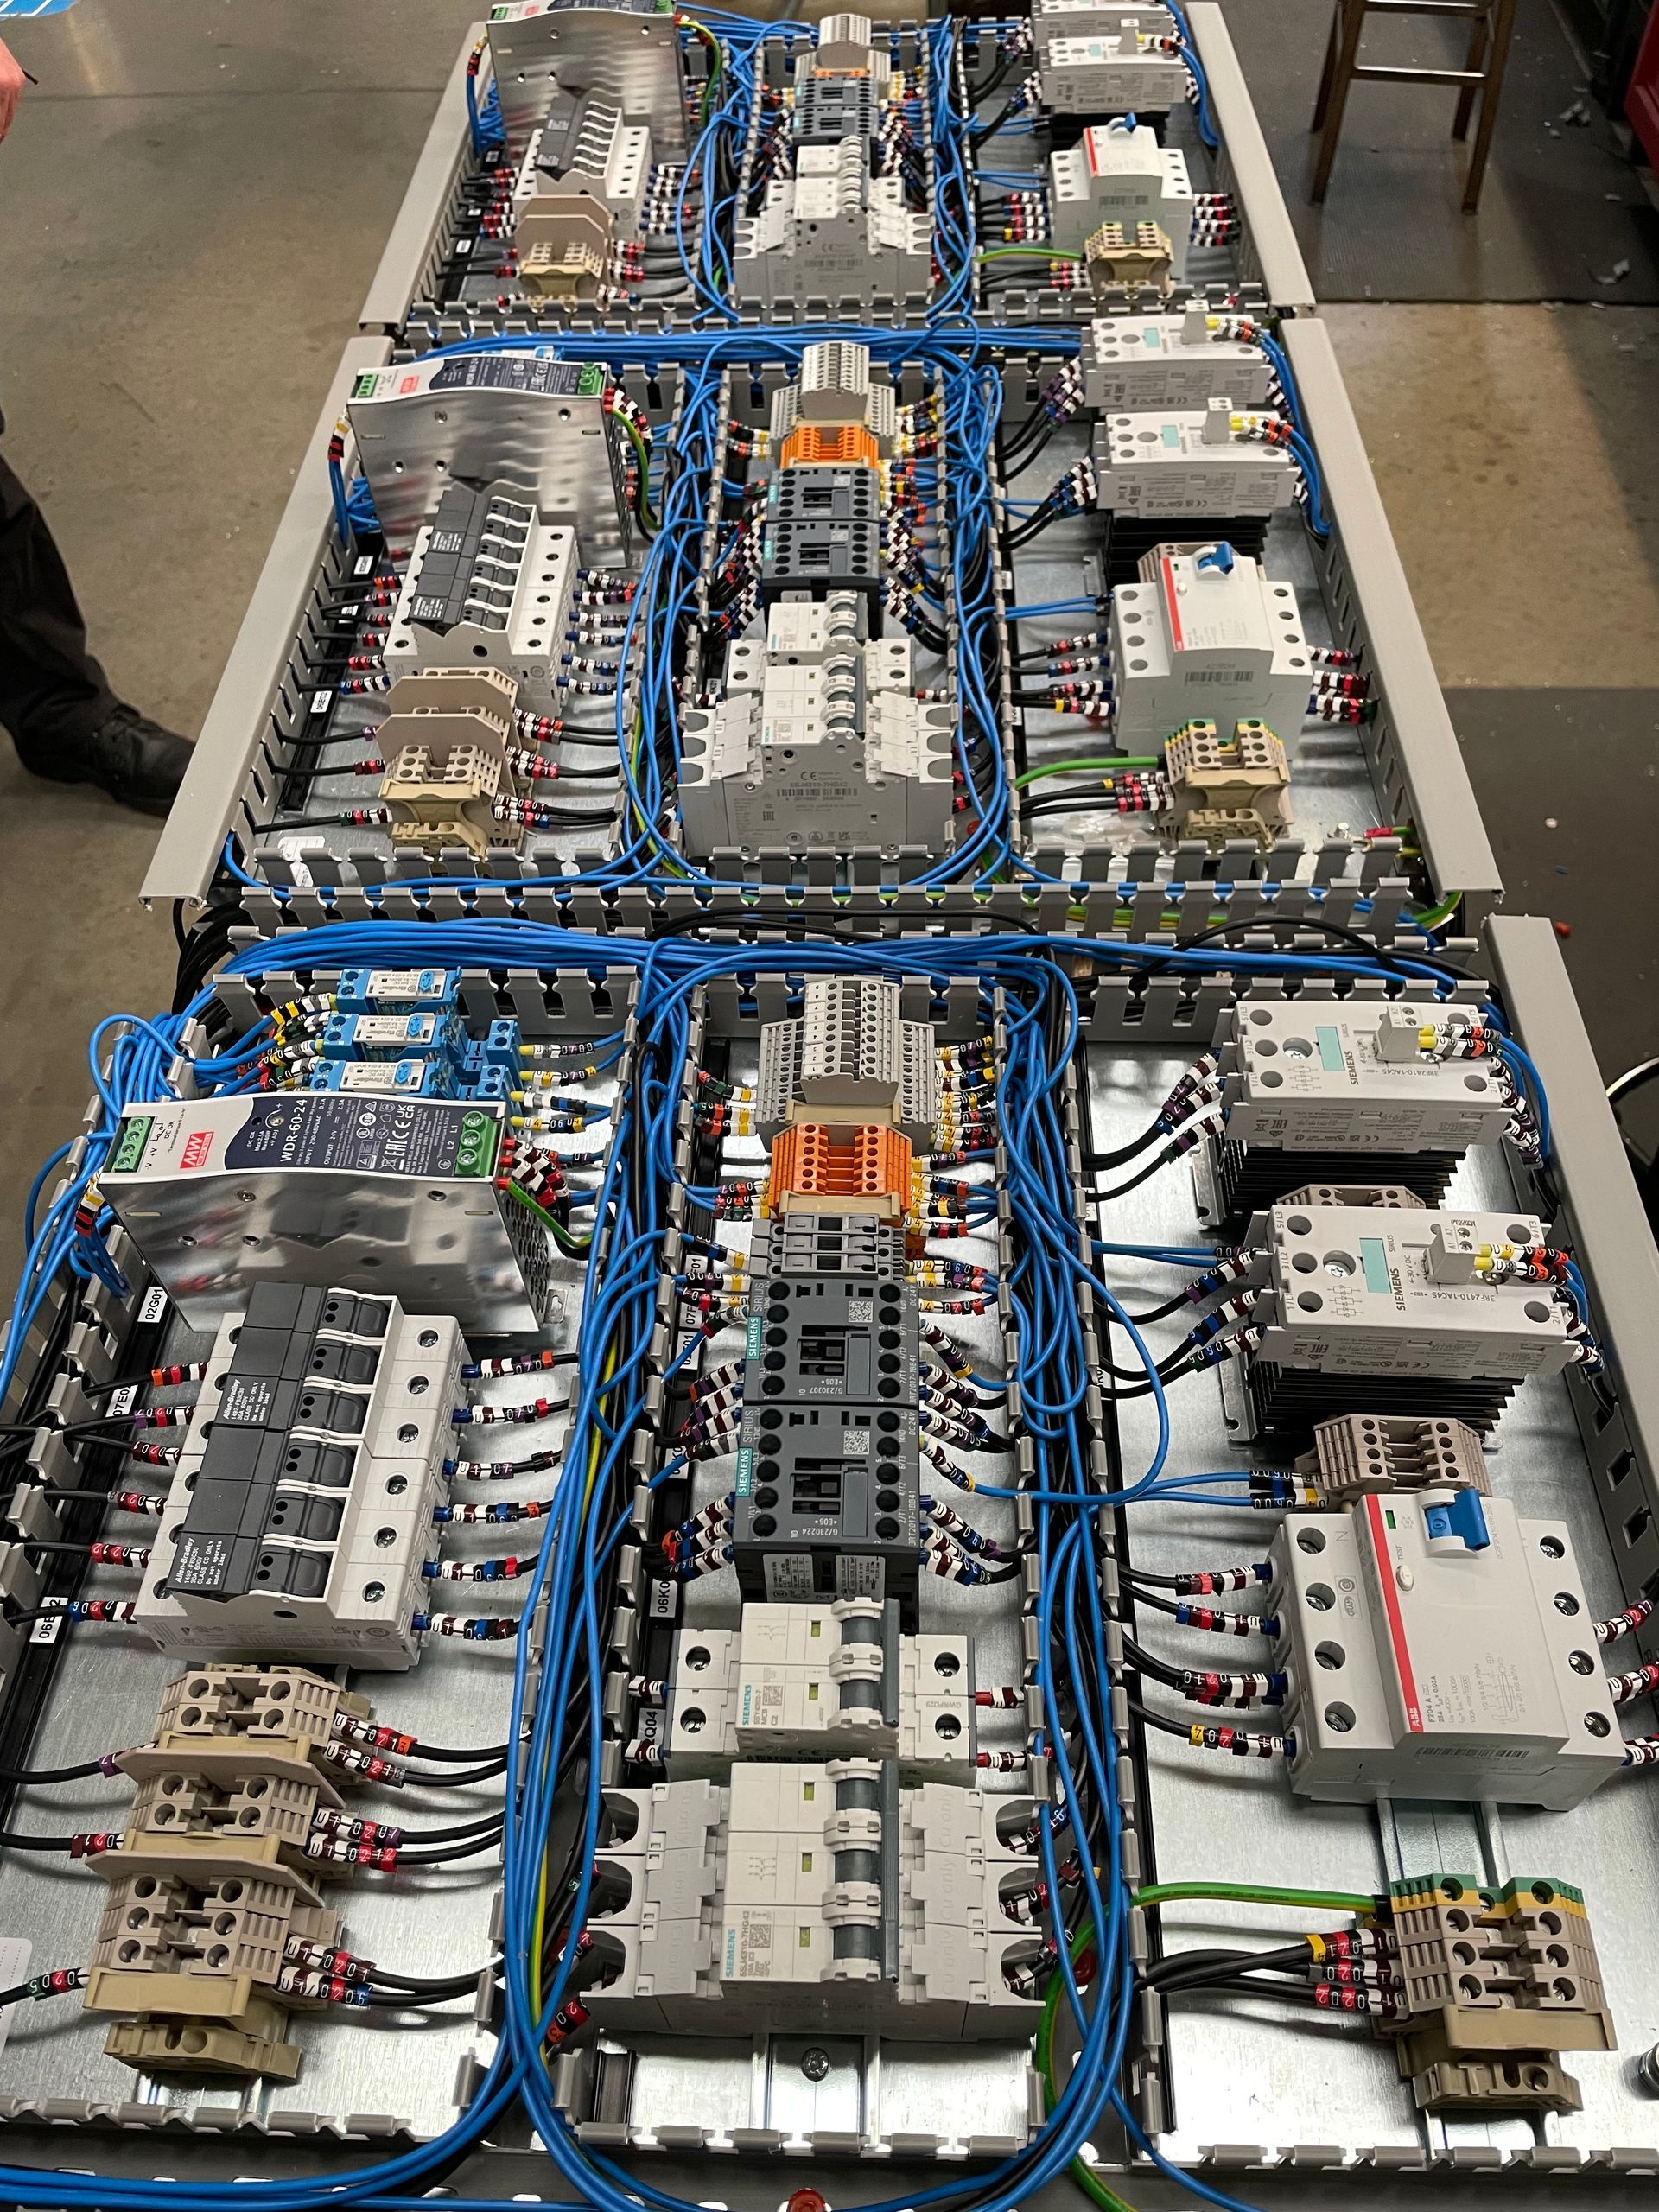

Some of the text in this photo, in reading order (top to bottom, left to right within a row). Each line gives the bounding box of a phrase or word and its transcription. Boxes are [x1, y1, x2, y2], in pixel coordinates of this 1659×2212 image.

[1344, 1051, 1359, 1085] SIEMENS
[396, 1104, 406, 1117] UK
[405, 1105, 416, 1119] CA
[280, 1099, 308, 1162] WDR-60-24
[446, 1125, 458, 1150] L2 L1
[1529, 1221, 1540, 1239] 6/T3
[145, 1288, 163, 1320] 02G01
[753, 1282, 765, 1313] SIRIUS
[909, 1284, 918, 1297] 24V
[1390, 1268, 1406, 1312] SIEMENS
[1432, 1291, 1495, 1301] 3RF2410-1AC45
[748, 1317, 759, 1357] SIEMENS
[223, 1379, 241, 1419] Allen-Bradley
[243, 1405, 252, 1421] CLASS
[743, 1409, 754, 1443] SIRIUS
[908, 1426, 916, 1436] DC
[738, 1448, 749, 1494] SIEMENS
[908, 1491, 917, 1546] 3RT2017-1BB41
[175, 1538, 195, 1583] Allen-Bradley
[213, 1541, 222, 1563] operate
[218, 1553, 226, 1566] load
[197, 1567, 207, 1585] CLASS
[203, 1556, 209, 1565] CC
[742, 1684, 752, 1726] SIEMENS
[1409, 1707, 1421, 1727] ABB
[1425, 1705, 1435, 1723] F204
[336, 1713, 408, 1754] U1-0213
[326, 1745, 403, 1780] U1-0218
[317, 1812, 399, 1840] U1-0207
[310, 1841, 396, 1864] U1-0212
[287, 1944, 370, 1982] U1-0201
[726, 1929, 736, 1978] SIEMENS
[1316, 1987, 1407, 2010] U1-0202
